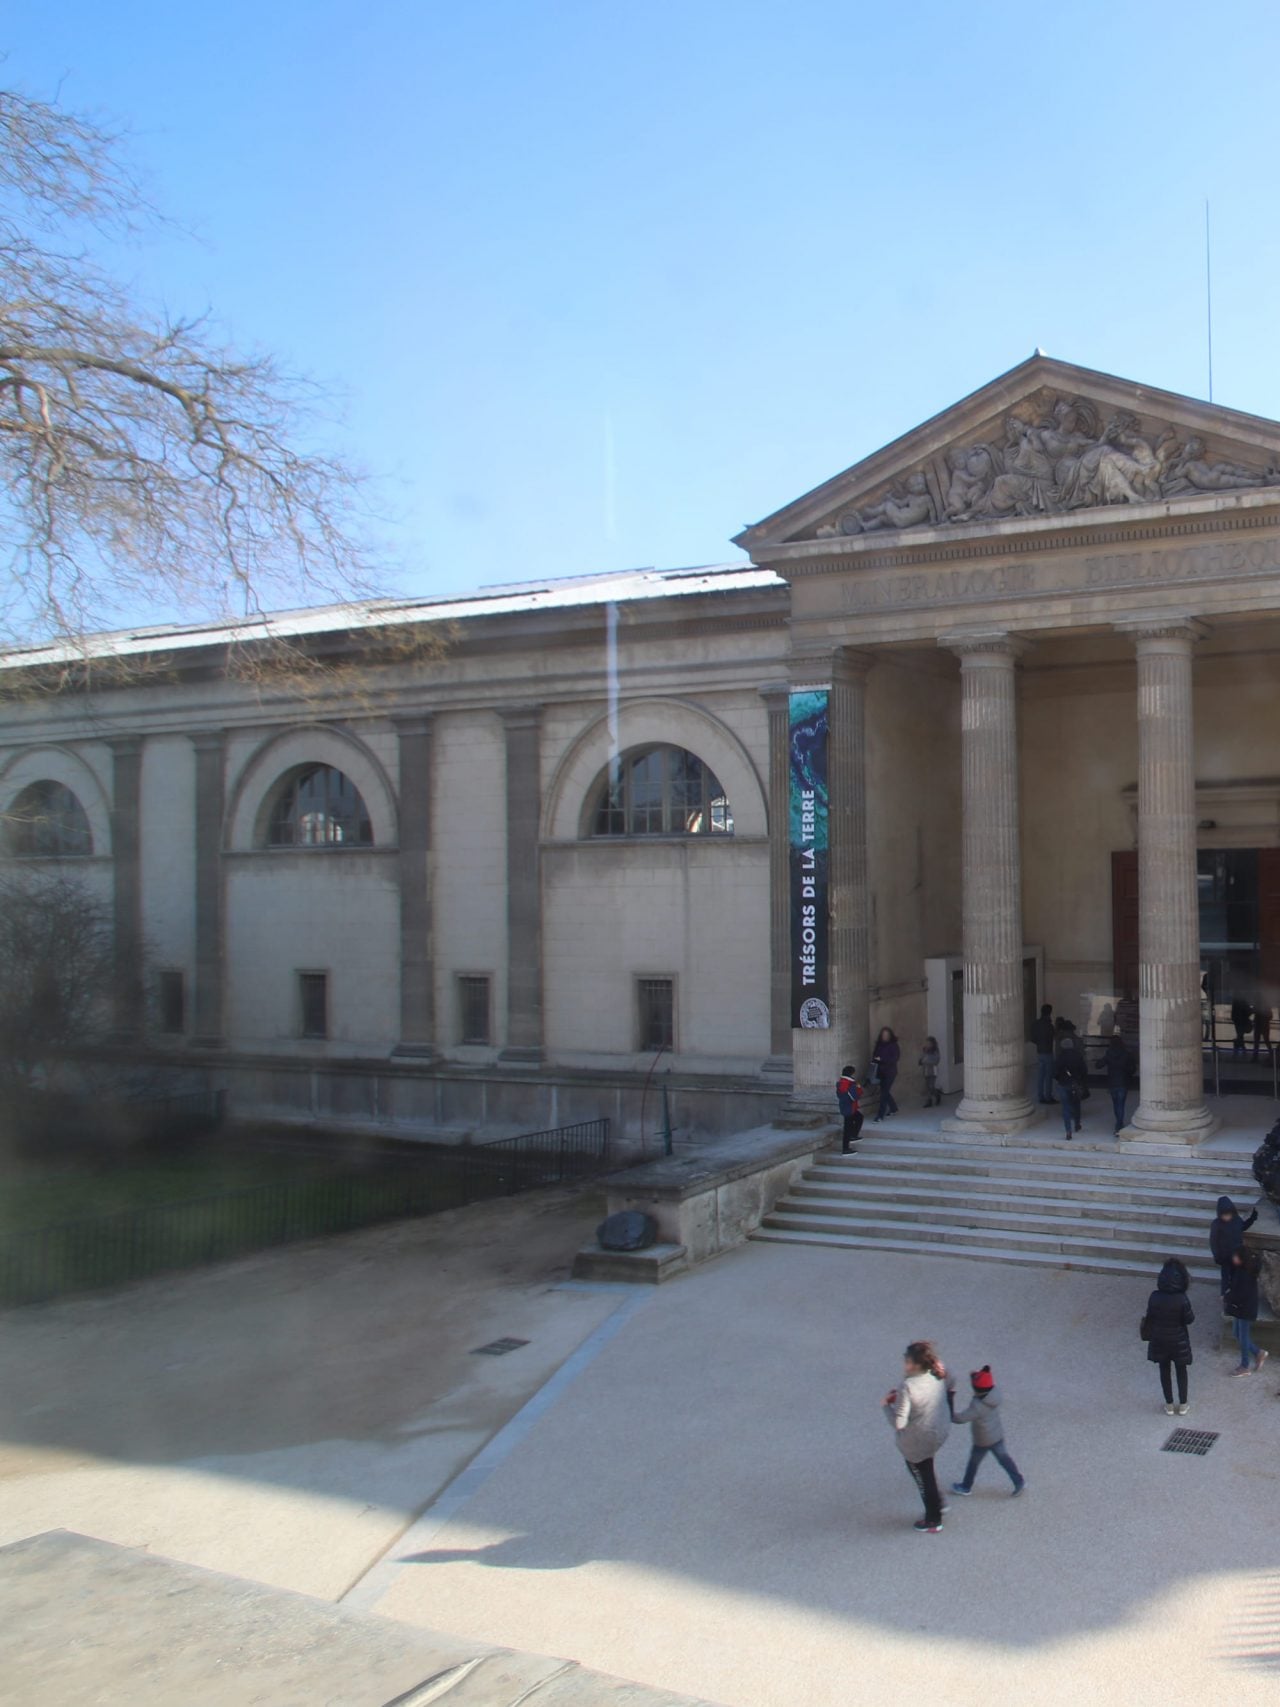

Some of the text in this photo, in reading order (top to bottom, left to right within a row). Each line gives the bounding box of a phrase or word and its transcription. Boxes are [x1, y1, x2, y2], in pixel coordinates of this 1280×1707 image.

[799, 789, 816, 986] TRÉSORS DE LA TERRE
